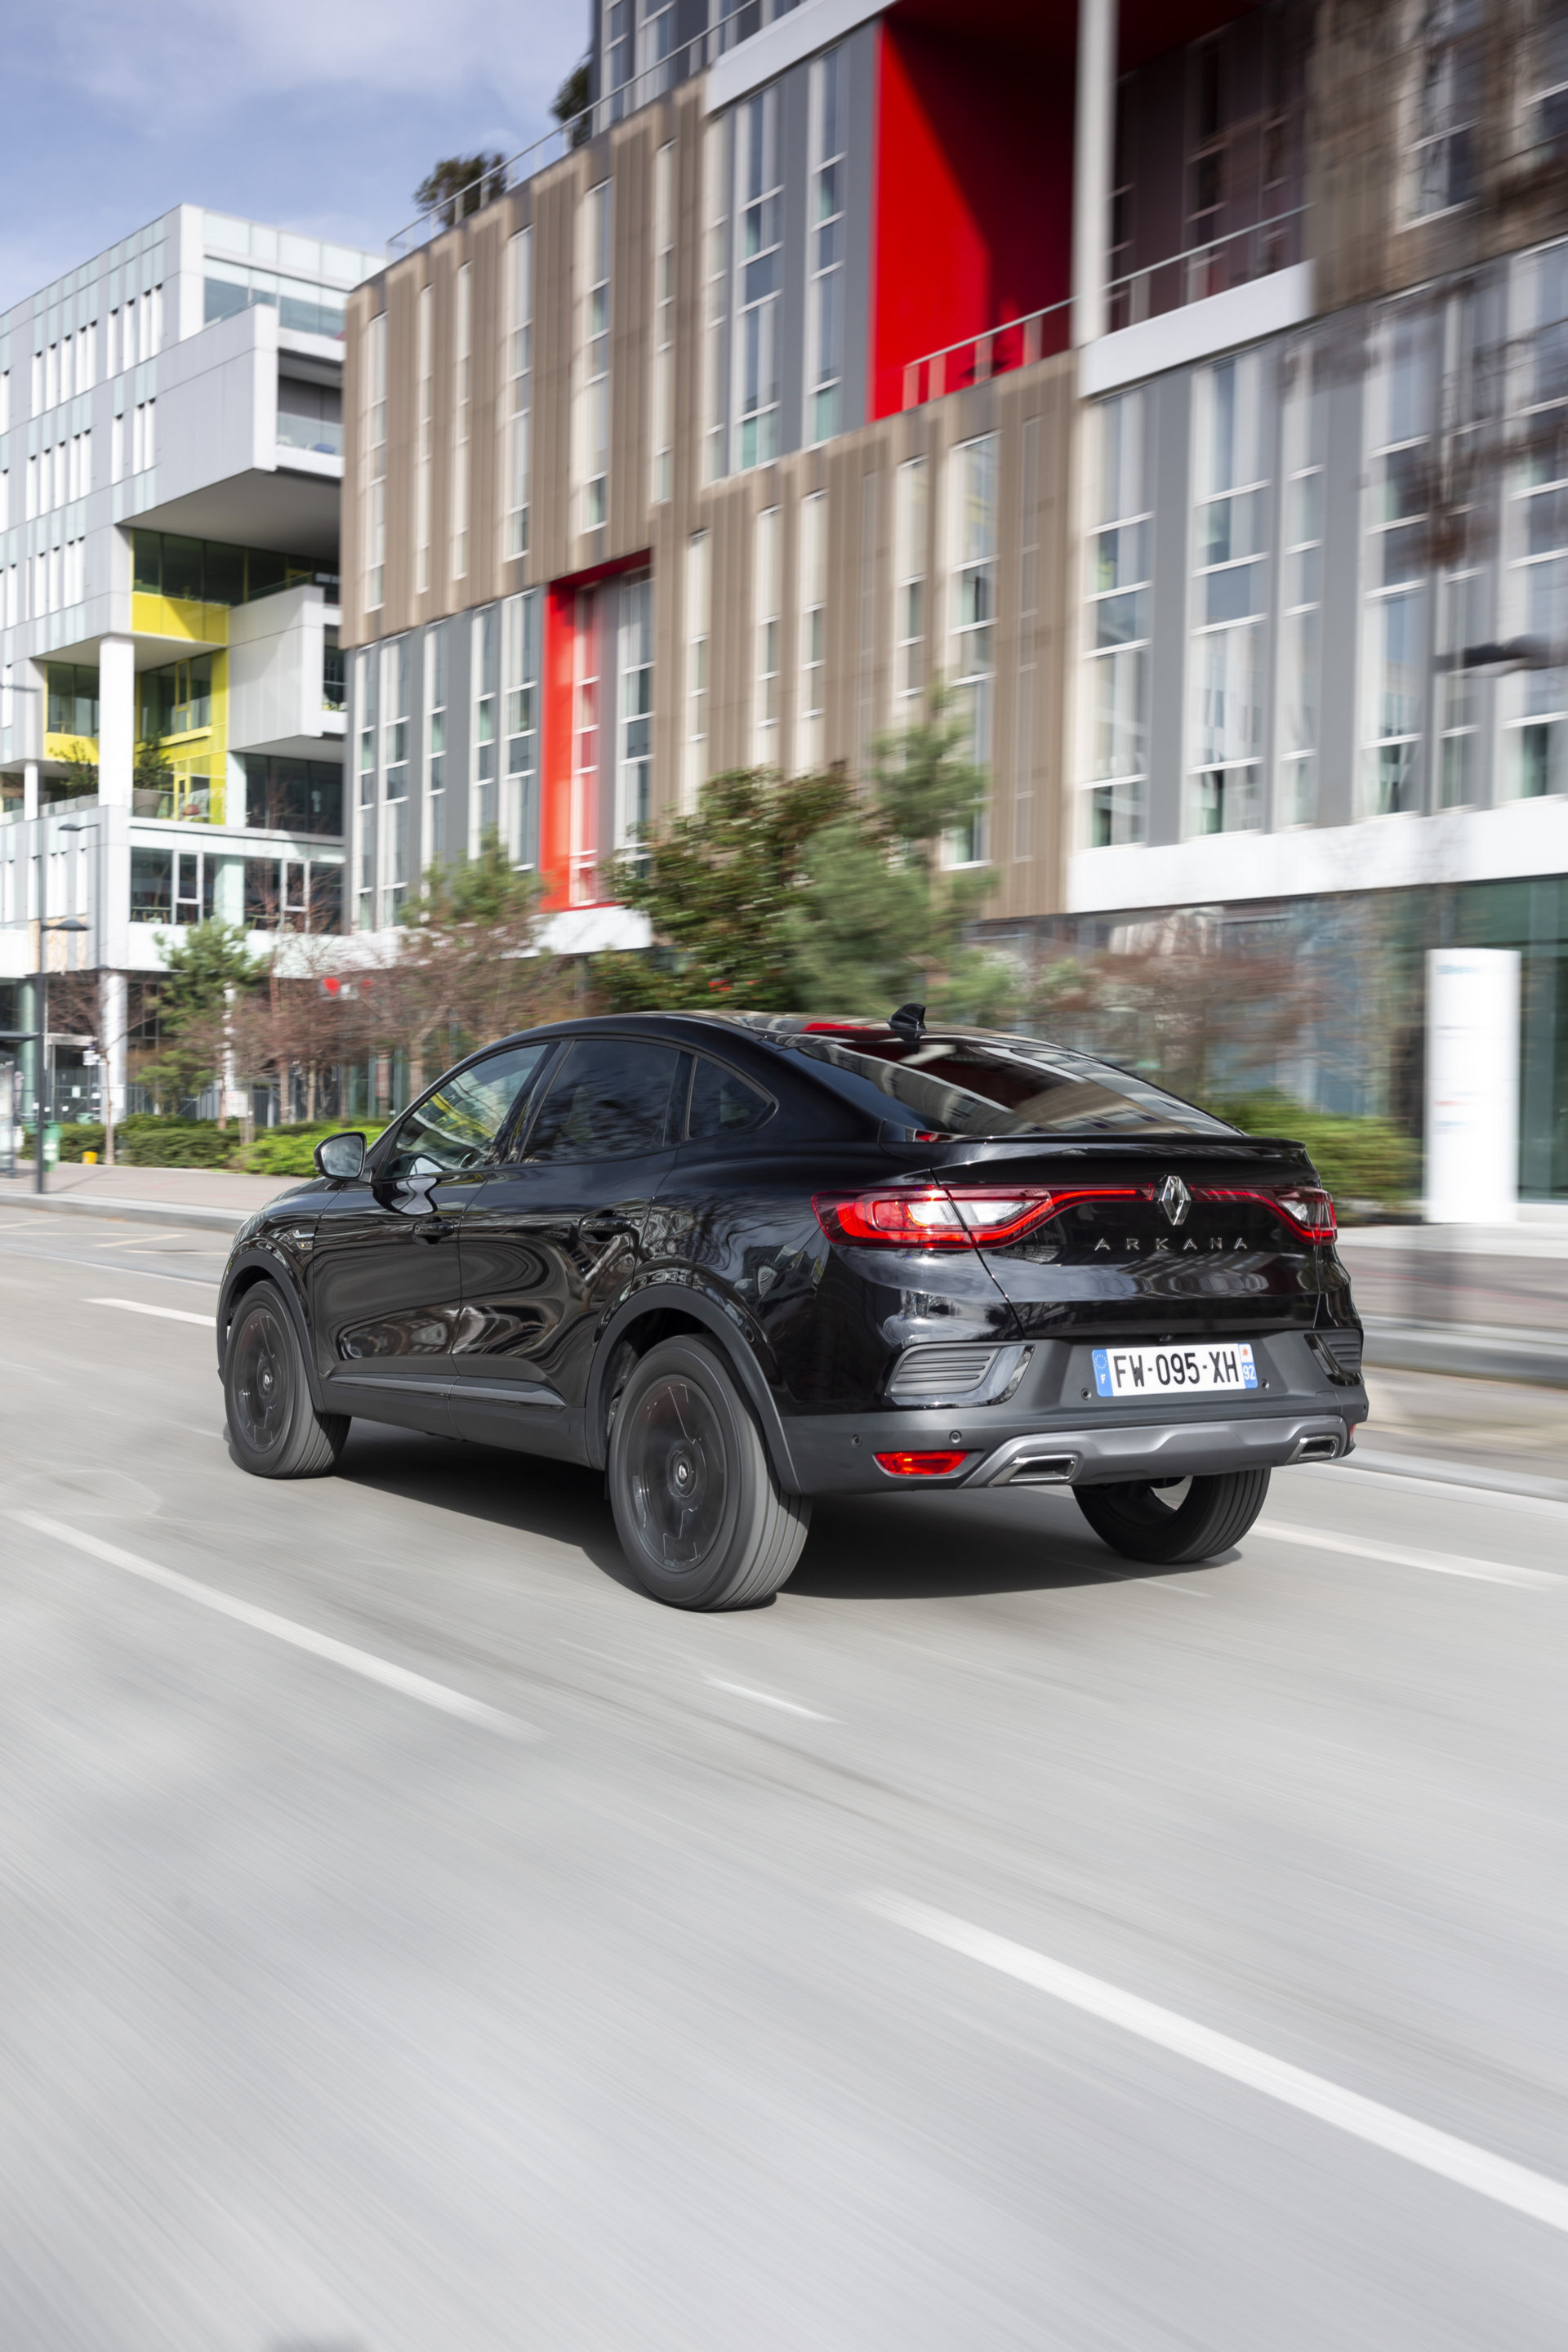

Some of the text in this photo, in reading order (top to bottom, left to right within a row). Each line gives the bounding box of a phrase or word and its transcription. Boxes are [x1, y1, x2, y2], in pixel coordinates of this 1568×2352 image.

[1094, 1237, 1248, 1250] ARKANA
[1113, 1351, 1240, 1388] FW-095-XH
[1242, 1365, 1256, 1381] 92
[1100, 1374, 1107, 1384] F
